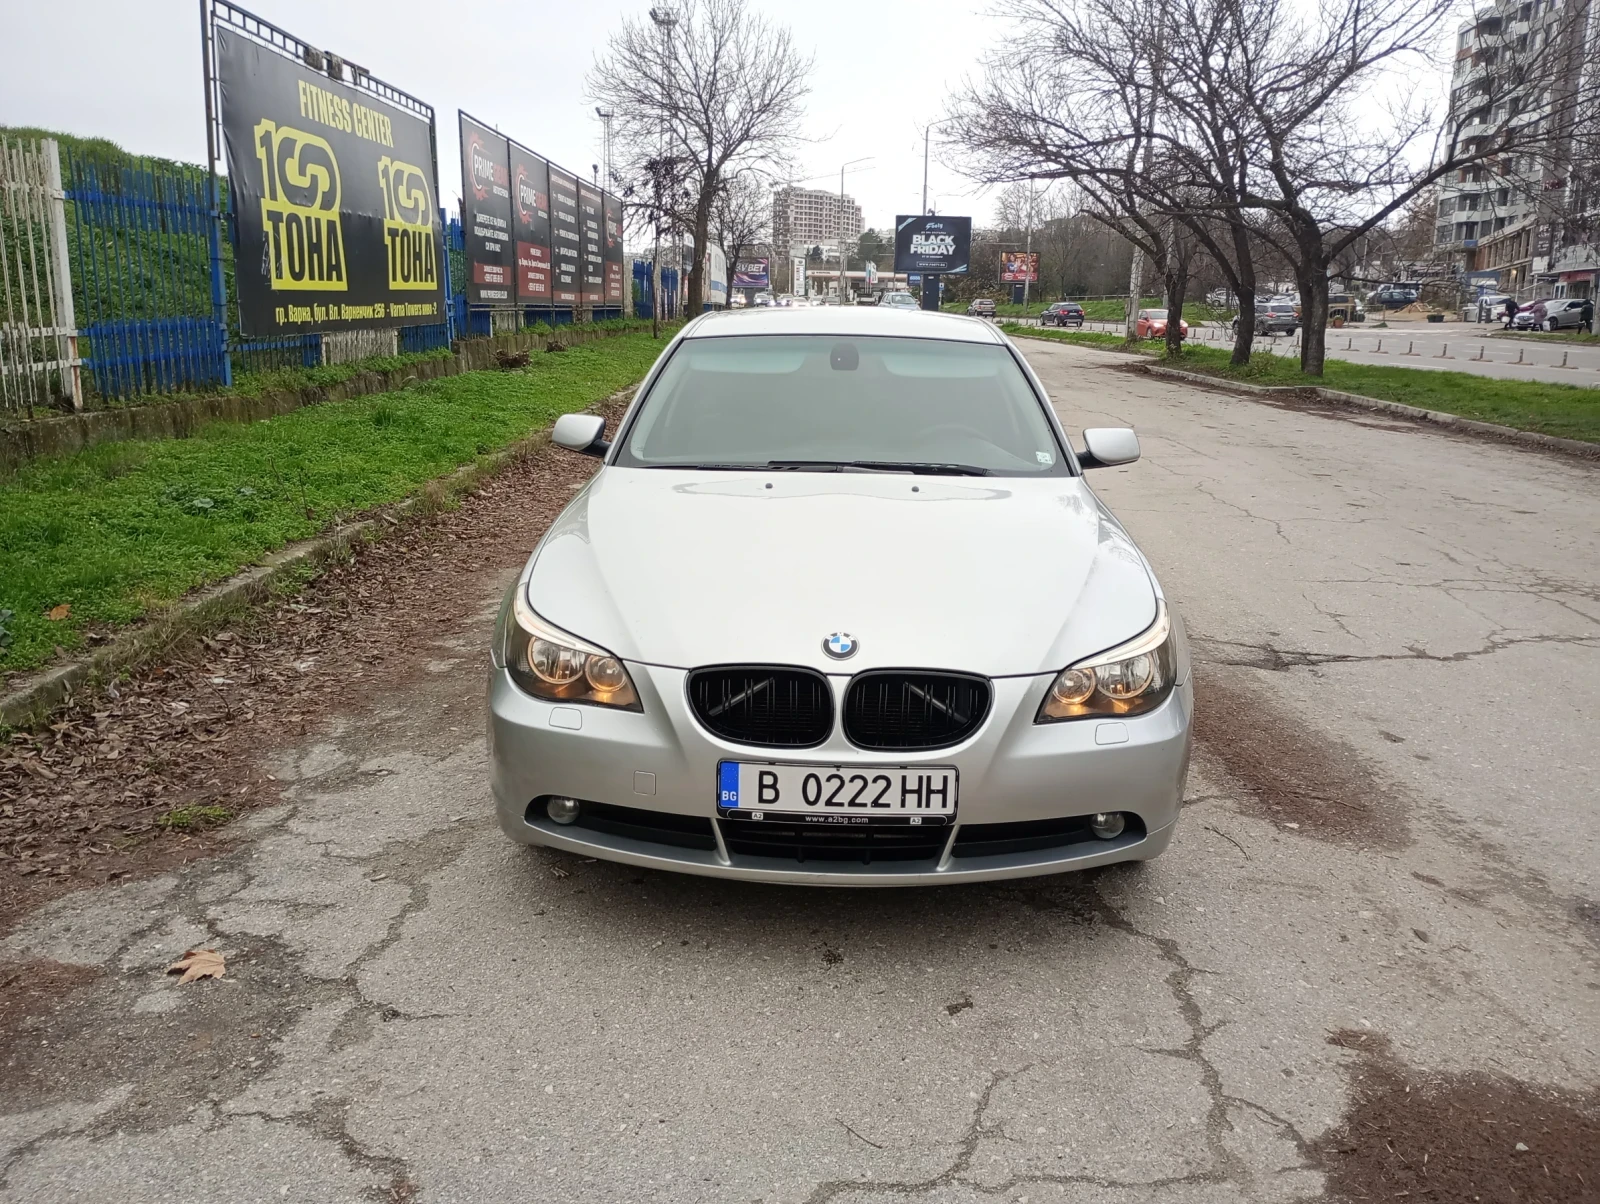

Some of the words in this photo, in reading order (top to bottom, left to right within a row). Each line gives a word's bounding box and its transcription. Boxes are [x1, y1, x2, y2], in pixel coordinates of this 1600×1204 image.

[298, 80, 352, 133] FITNESS
[352, 103, 394, 148] CENTER
[267, 211, 344, 283] ТОНА
[912, 234, 954, 245] BLACK
[387, 228, 434, 284] ТОНА
[910, 244, 956, 255] FRIDAY
[275, 306, 287, 325] гр.
[288, 304, 314, 325] Варна,
[314, 303, 328, 324] бул.
[329, 304, 340, 320] Вл.
[341, 303, 374, 322] Варненчик
[374, 303, 385, 318] 256
[722, 790, 737, 801] BG
[758, 770, 780, 805] B
[752, 812, 763, 820] A2
[804, 814, 869, 824] www.a2bg.com
